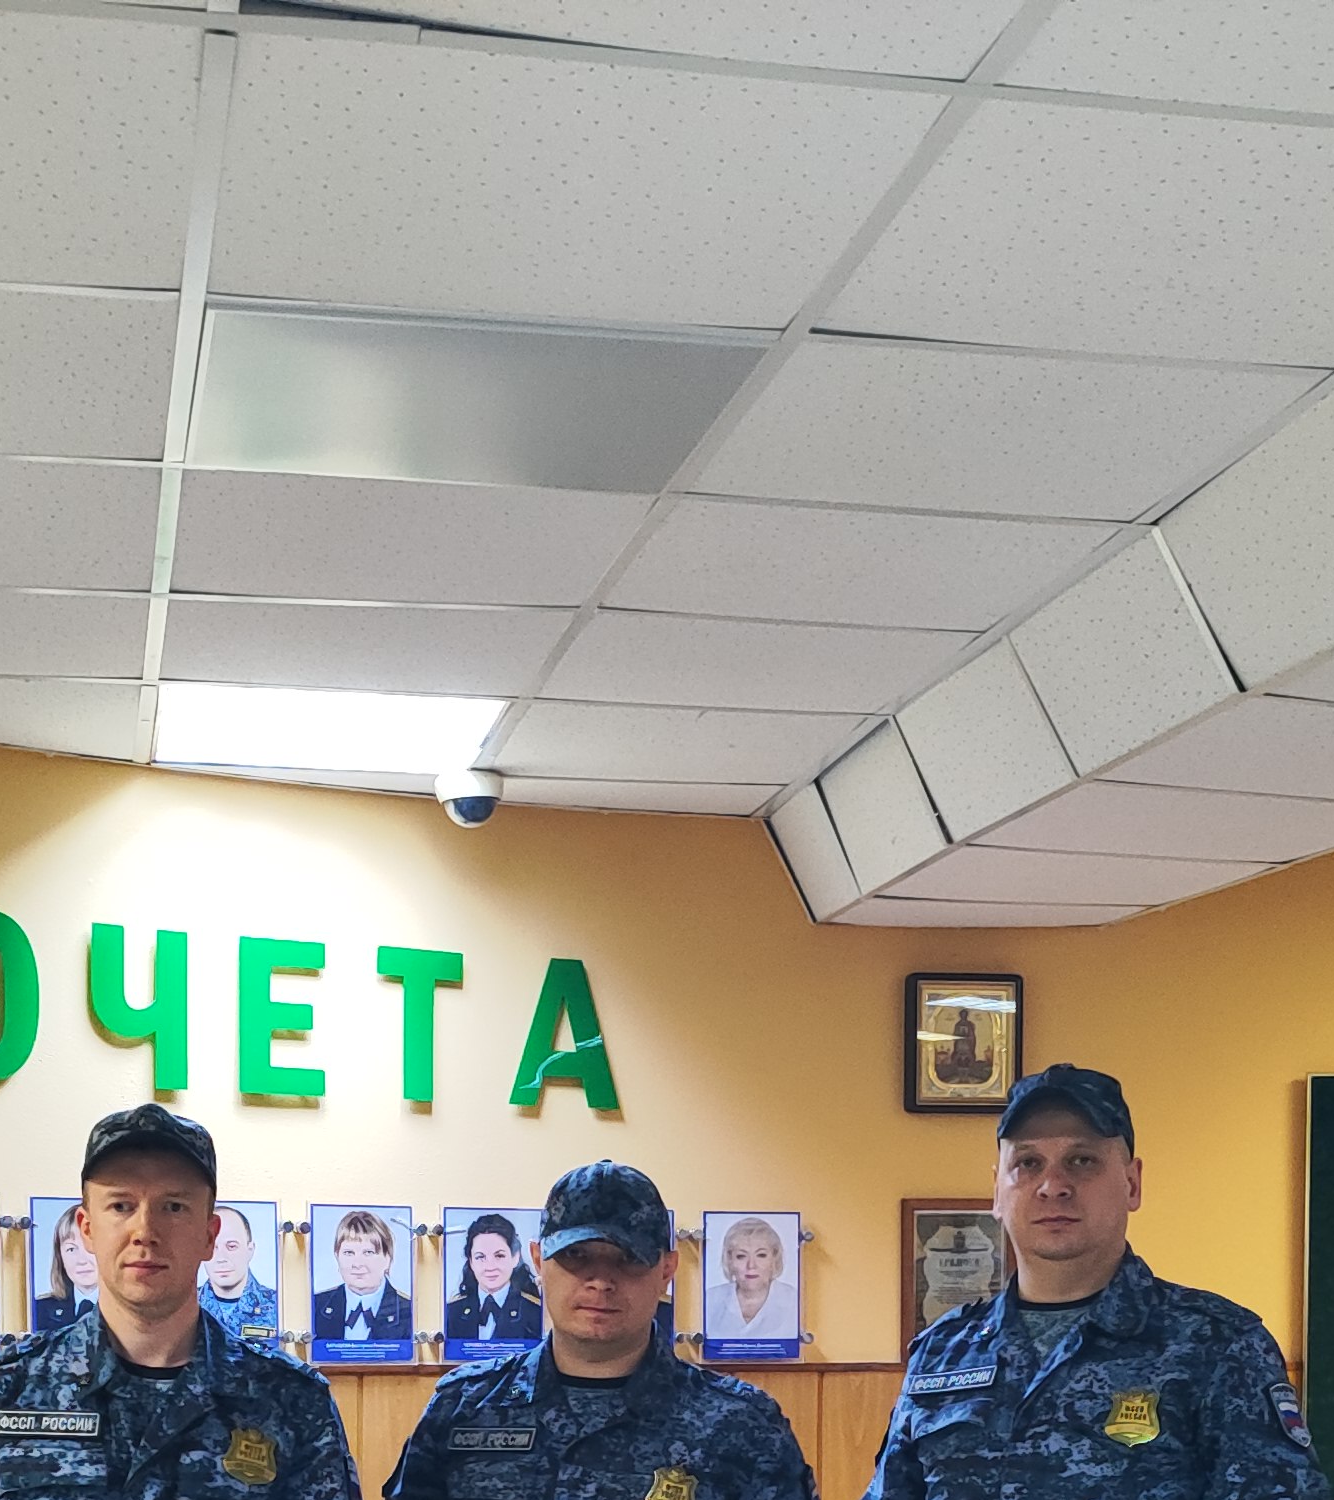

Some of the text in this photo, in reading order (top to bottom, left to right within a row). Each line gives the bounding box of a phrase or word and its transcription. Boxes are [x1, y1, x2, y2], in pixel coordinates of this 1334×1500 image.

[915, 1369, 992, 1391] ФССП РОССИИ
[0, 1415, 97, 1432] ФССП РОССИИ
[486, 1432, 529, 1446] РОССИИ
